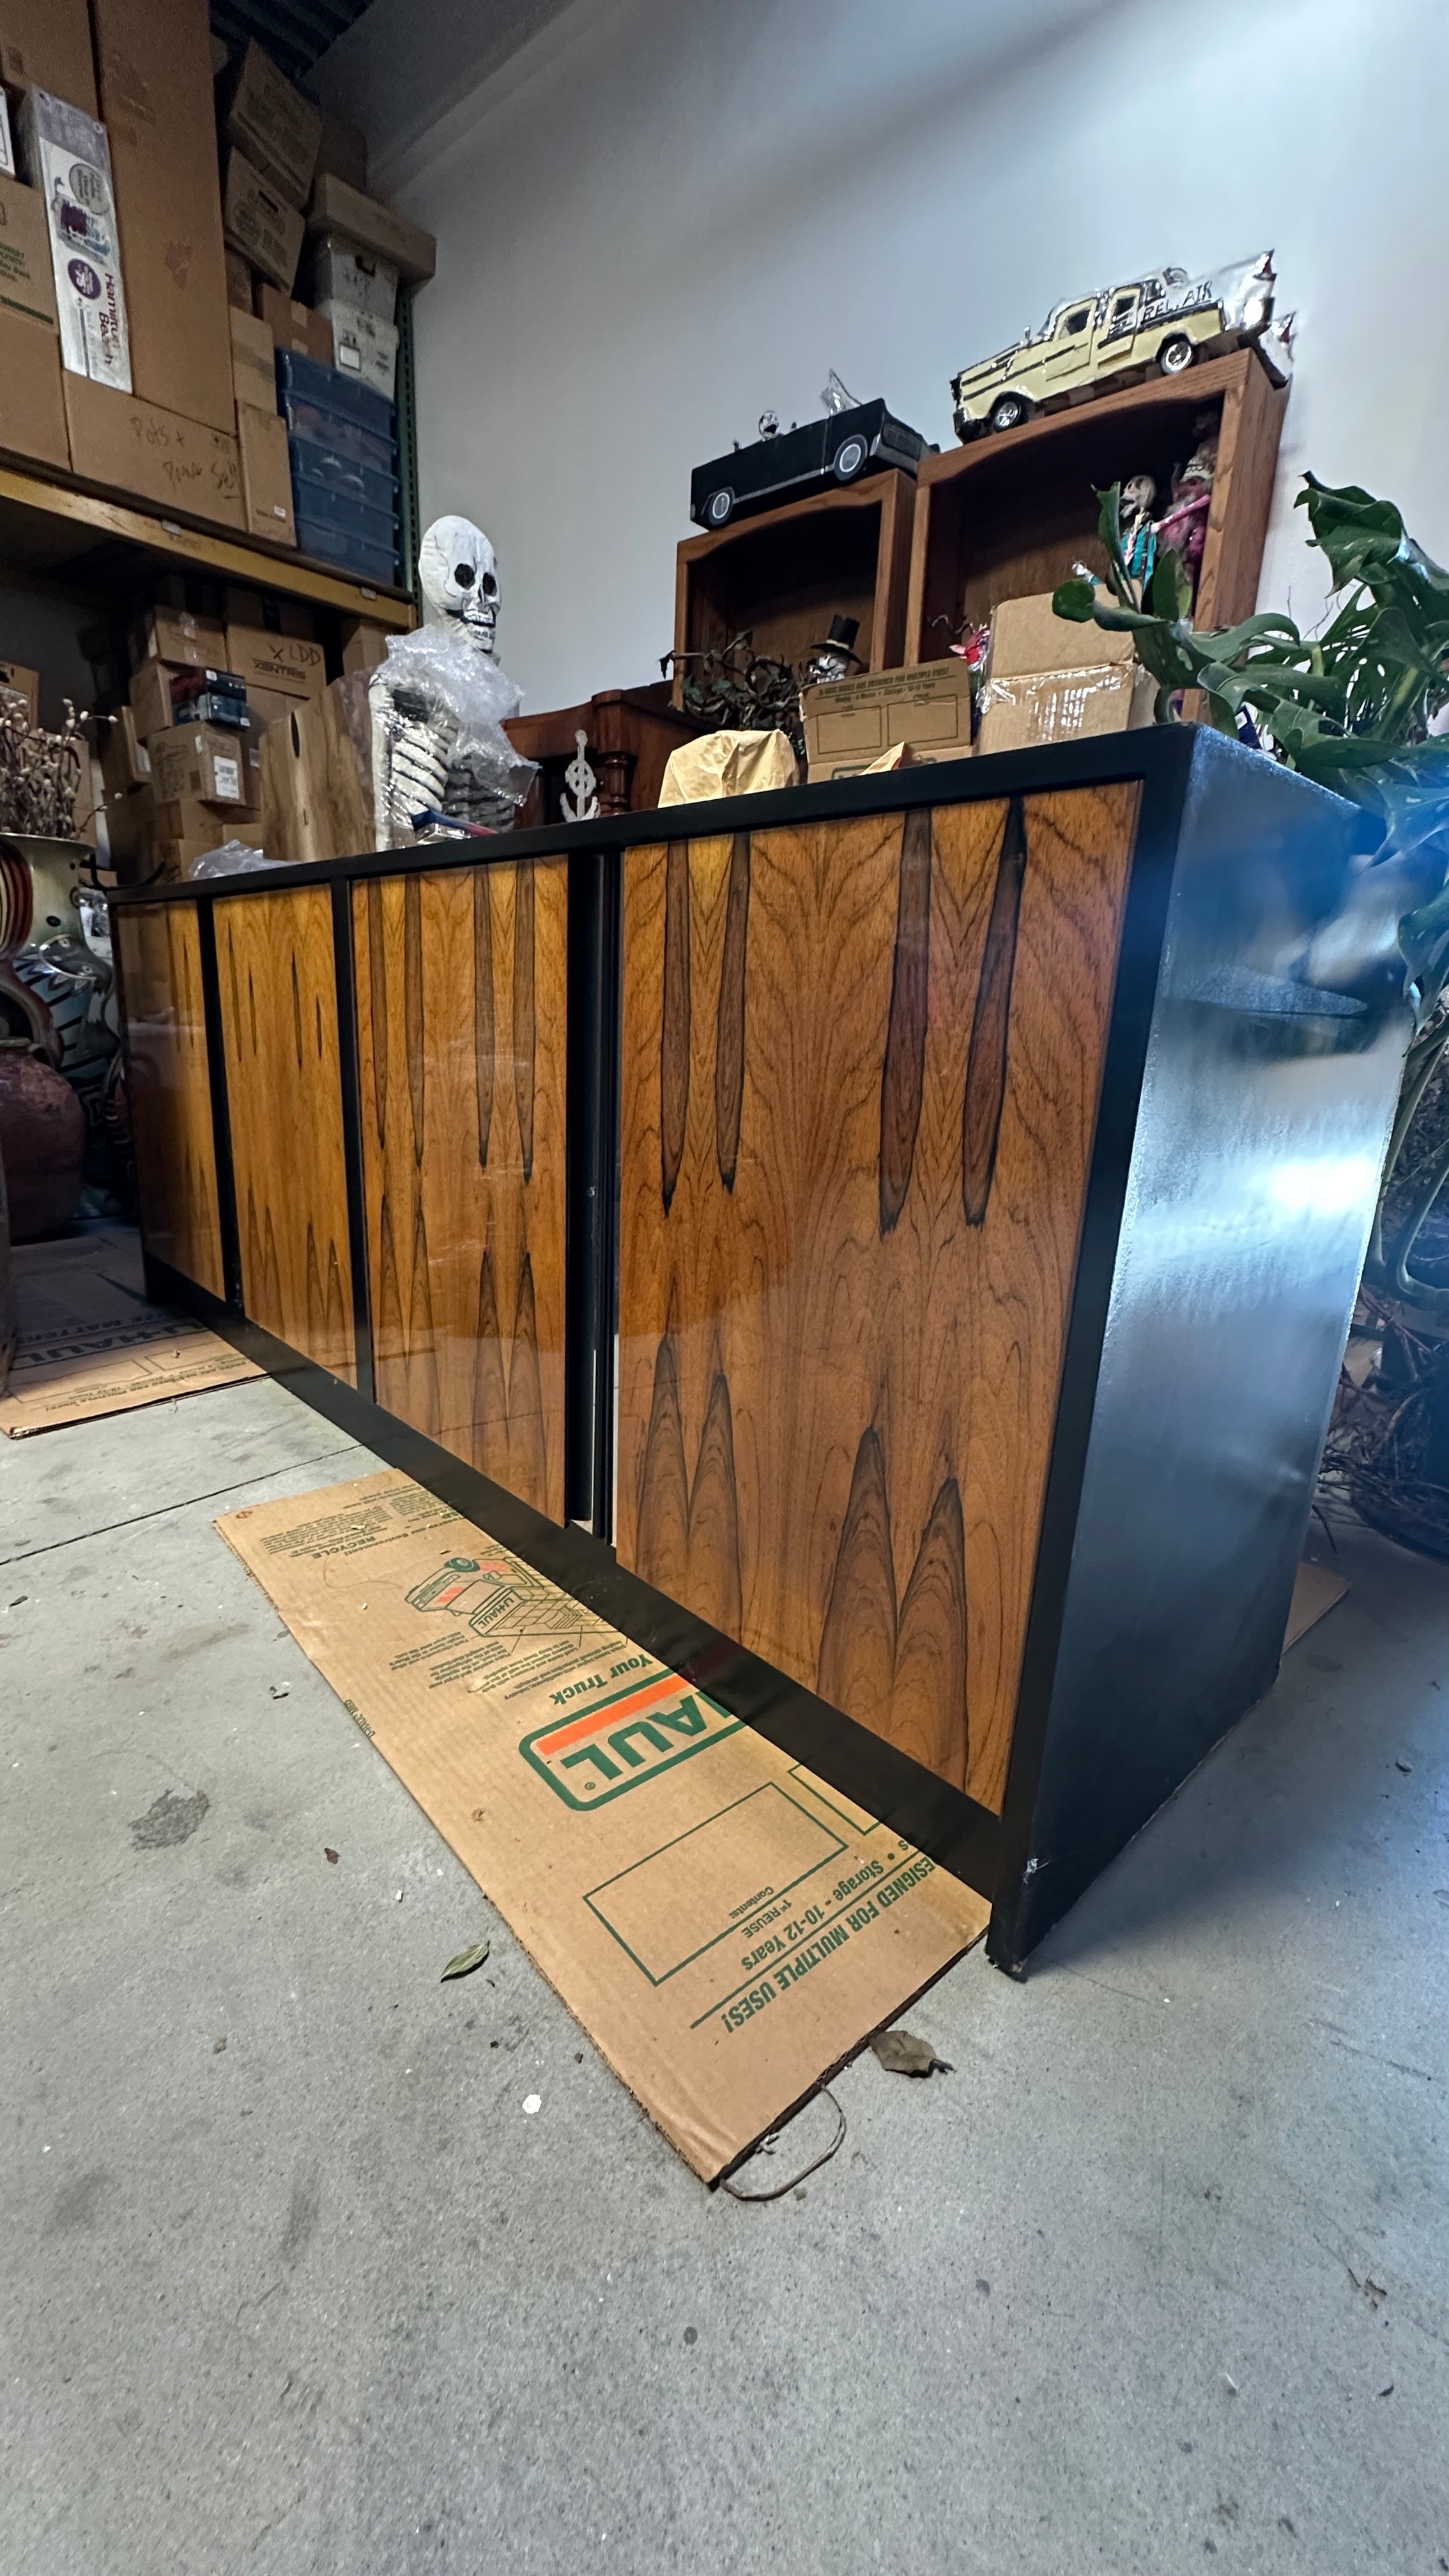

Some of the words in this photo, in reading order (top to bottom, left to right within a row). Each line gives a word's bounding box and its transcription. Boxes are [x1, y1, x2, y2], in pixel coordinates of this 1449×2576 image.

[104, 272, 119, 349] Hamilton
[251, 658, 307, 680] XENTRIS
[310, 1535, 376, 1559] RECYCLE
[341, 1532, 409, 1556] Environment!
[609, 1650, 653, 1679] Your
[549, 1673, 608, 1705] Truck
[832, 1859, 884, 1901] Storage
[877, 1859, 936, 1908] ESIGNED
[728, 1885, 774, 1919] Contents:
[845, 1899, 880, 1932] FOR
[741, 1906, 781, 1938] REUSE
[783, 1904, 825, 1941] 10-12
[740, 1935, 786, 1971] Years
[773, 1924, 849, 1990] MULTIPLE
[721, 1981, 776, 2033] USES!
